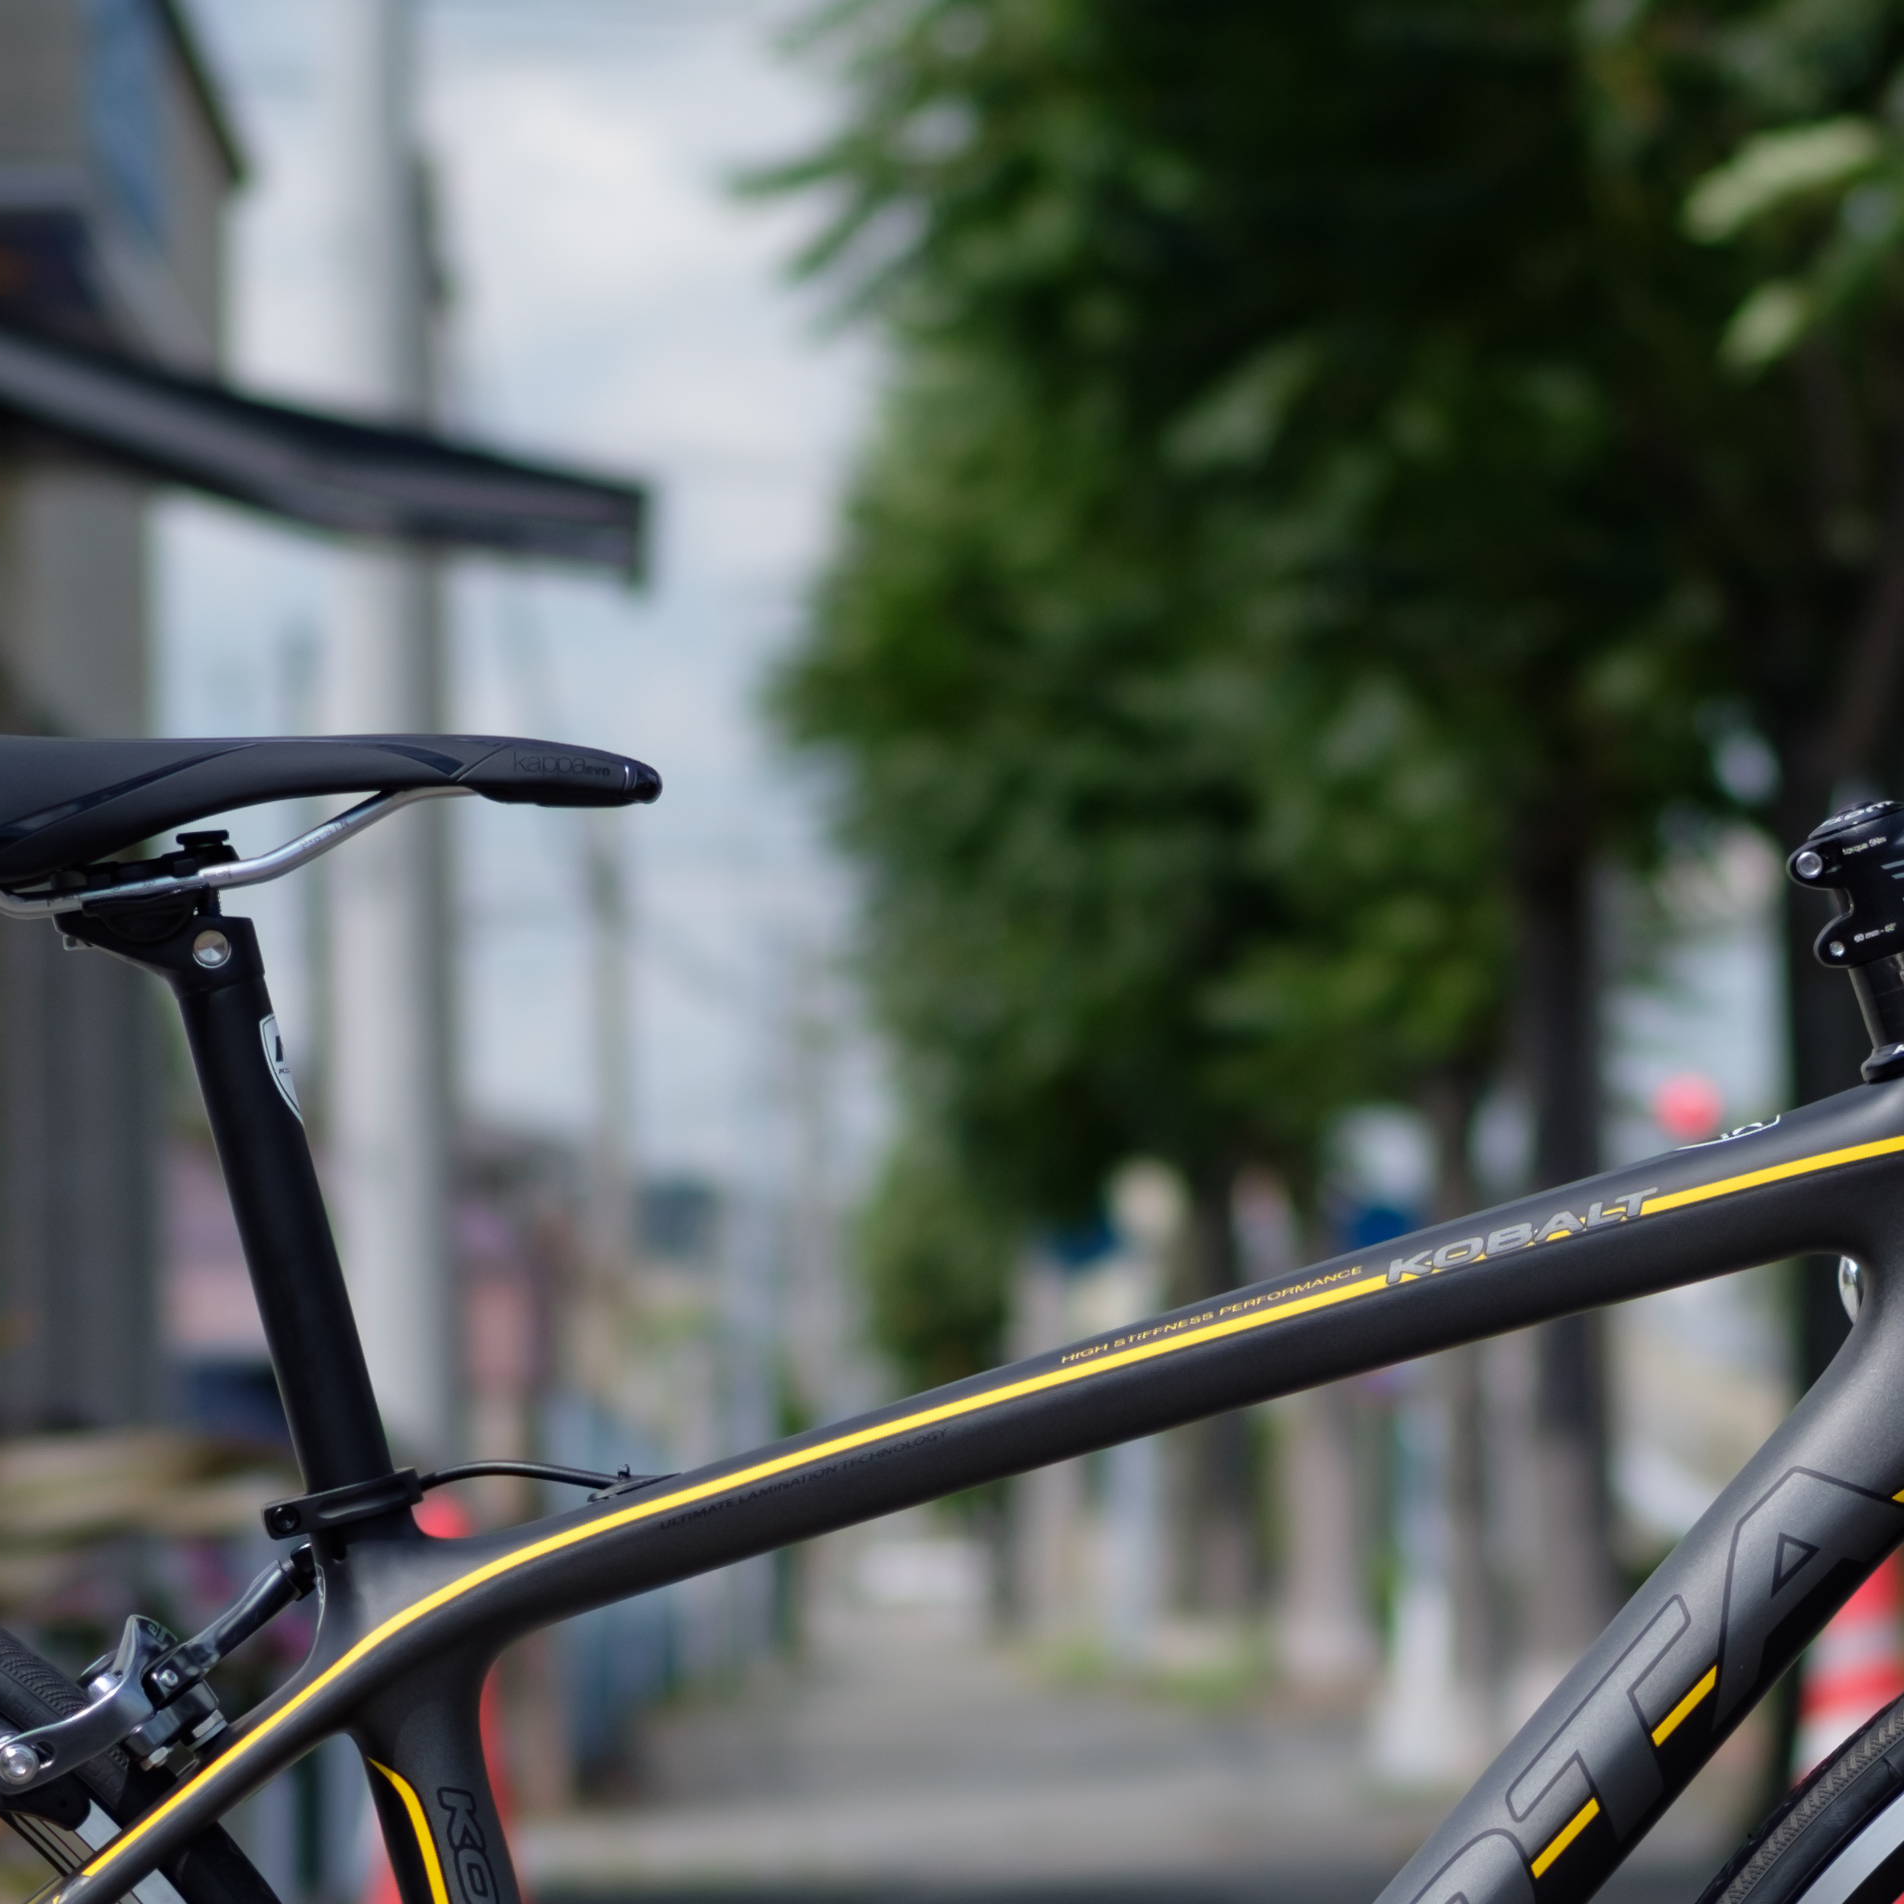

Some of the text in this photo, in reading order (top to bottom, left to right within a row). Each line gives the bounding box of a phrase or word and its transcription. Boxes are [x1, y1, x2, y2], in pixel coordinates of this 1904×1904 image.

[1385, 1186, 1662, 1285] KOBALT
[1060, 1265, 1363, 1365] HIGH STIFFNESS PERFORMANCE
[659, 1427, 950, 1531] ULTIMATE LAMINATION TECHNOLOGY
